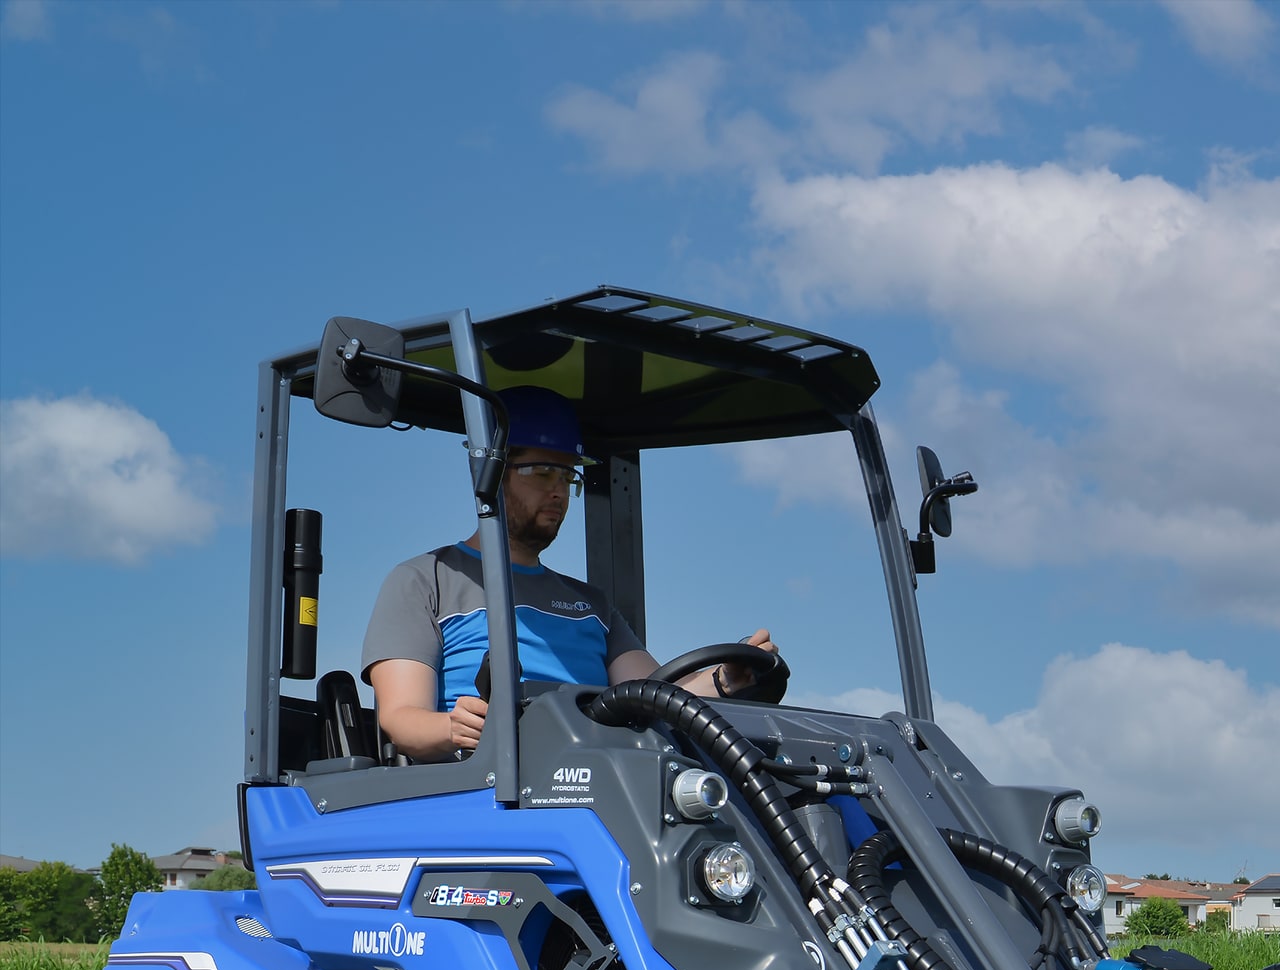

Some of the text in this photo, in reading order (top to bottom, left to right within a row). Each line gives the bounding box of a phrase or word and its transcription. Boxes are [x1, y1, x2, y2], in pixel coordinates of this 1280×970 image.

[553, 767, 592, 783] 4WD
[531, 796, 594, 804] www.multione.com
[375, 863, 401, 872] FLOW
[436, 885, 464, 906] 8.4
